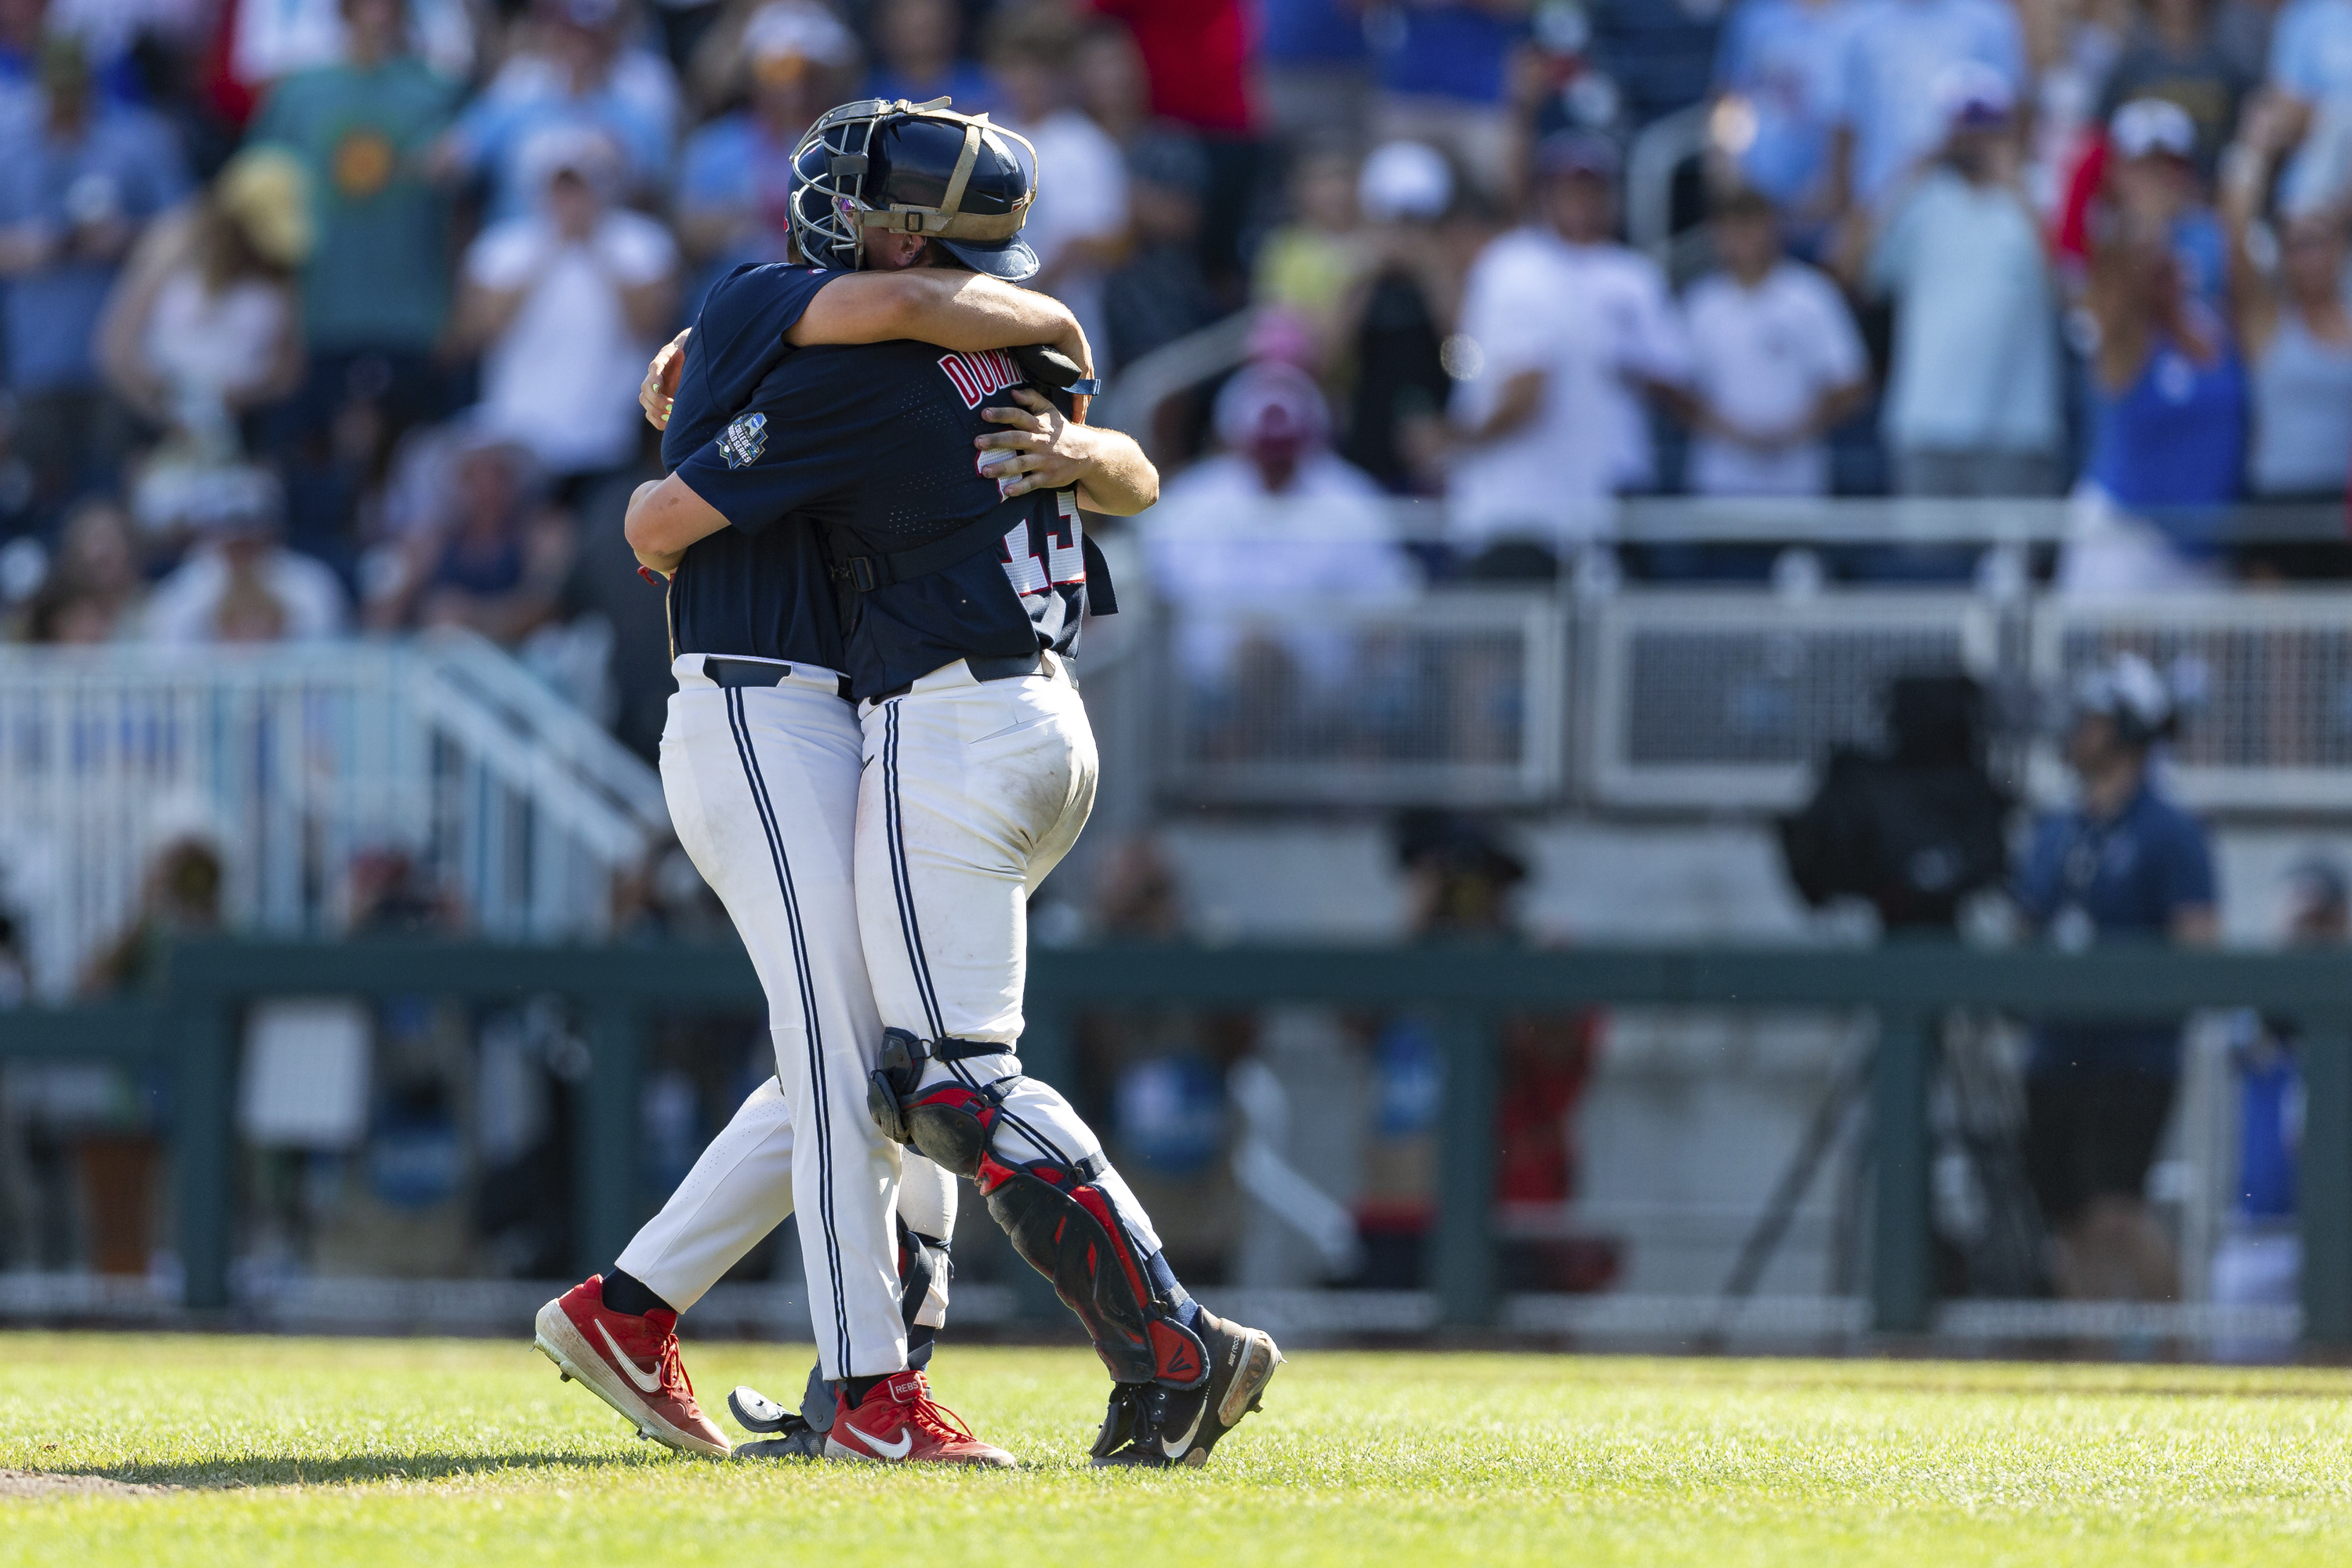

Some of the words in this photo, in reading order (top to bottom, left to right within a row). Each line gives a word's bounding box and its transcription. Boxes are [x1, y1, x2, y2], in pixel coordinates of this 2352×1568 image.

[937, 347, 1025, 410] DUNH
[735, 423, 751, 449] COLLEGE
[733, 440, 752, 463] SERIES
[895, 1381, 919, 1395] REBS
